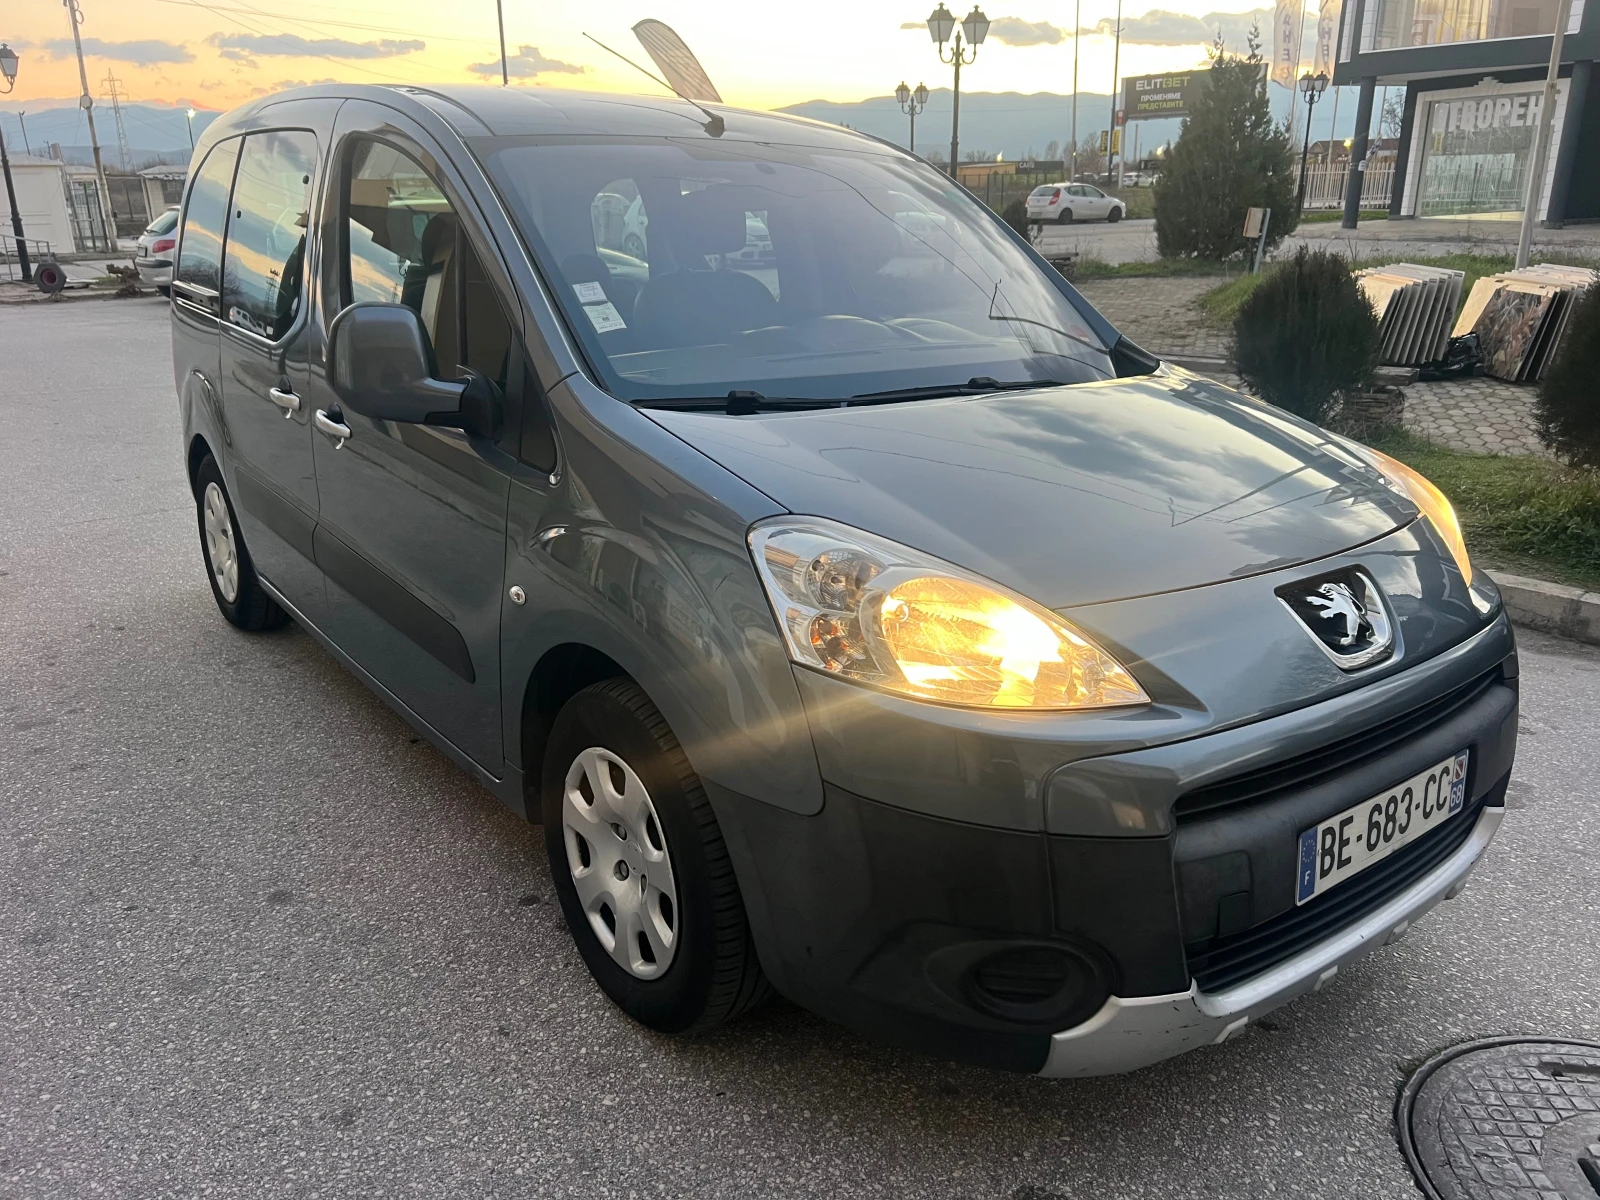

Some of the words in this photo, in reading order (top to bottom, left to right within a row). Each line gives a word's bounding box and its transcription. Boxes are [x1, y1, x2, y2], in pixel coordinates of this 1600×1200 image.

[1136, 76, 1190, 90] ELITBET
[1141, 92, 1181, 102] ПРОМЕНЯМЕ
[1137, 100, 1184, 111] ПРЕДСТАВИТЕ
[1433, 94, 1556, 133] ОТВОРЕН
[1451, 785, 1463, 806] 68
[1319, 766, 1450, 880] BE-683-CC
[1304, 870, 1311, 886] F
